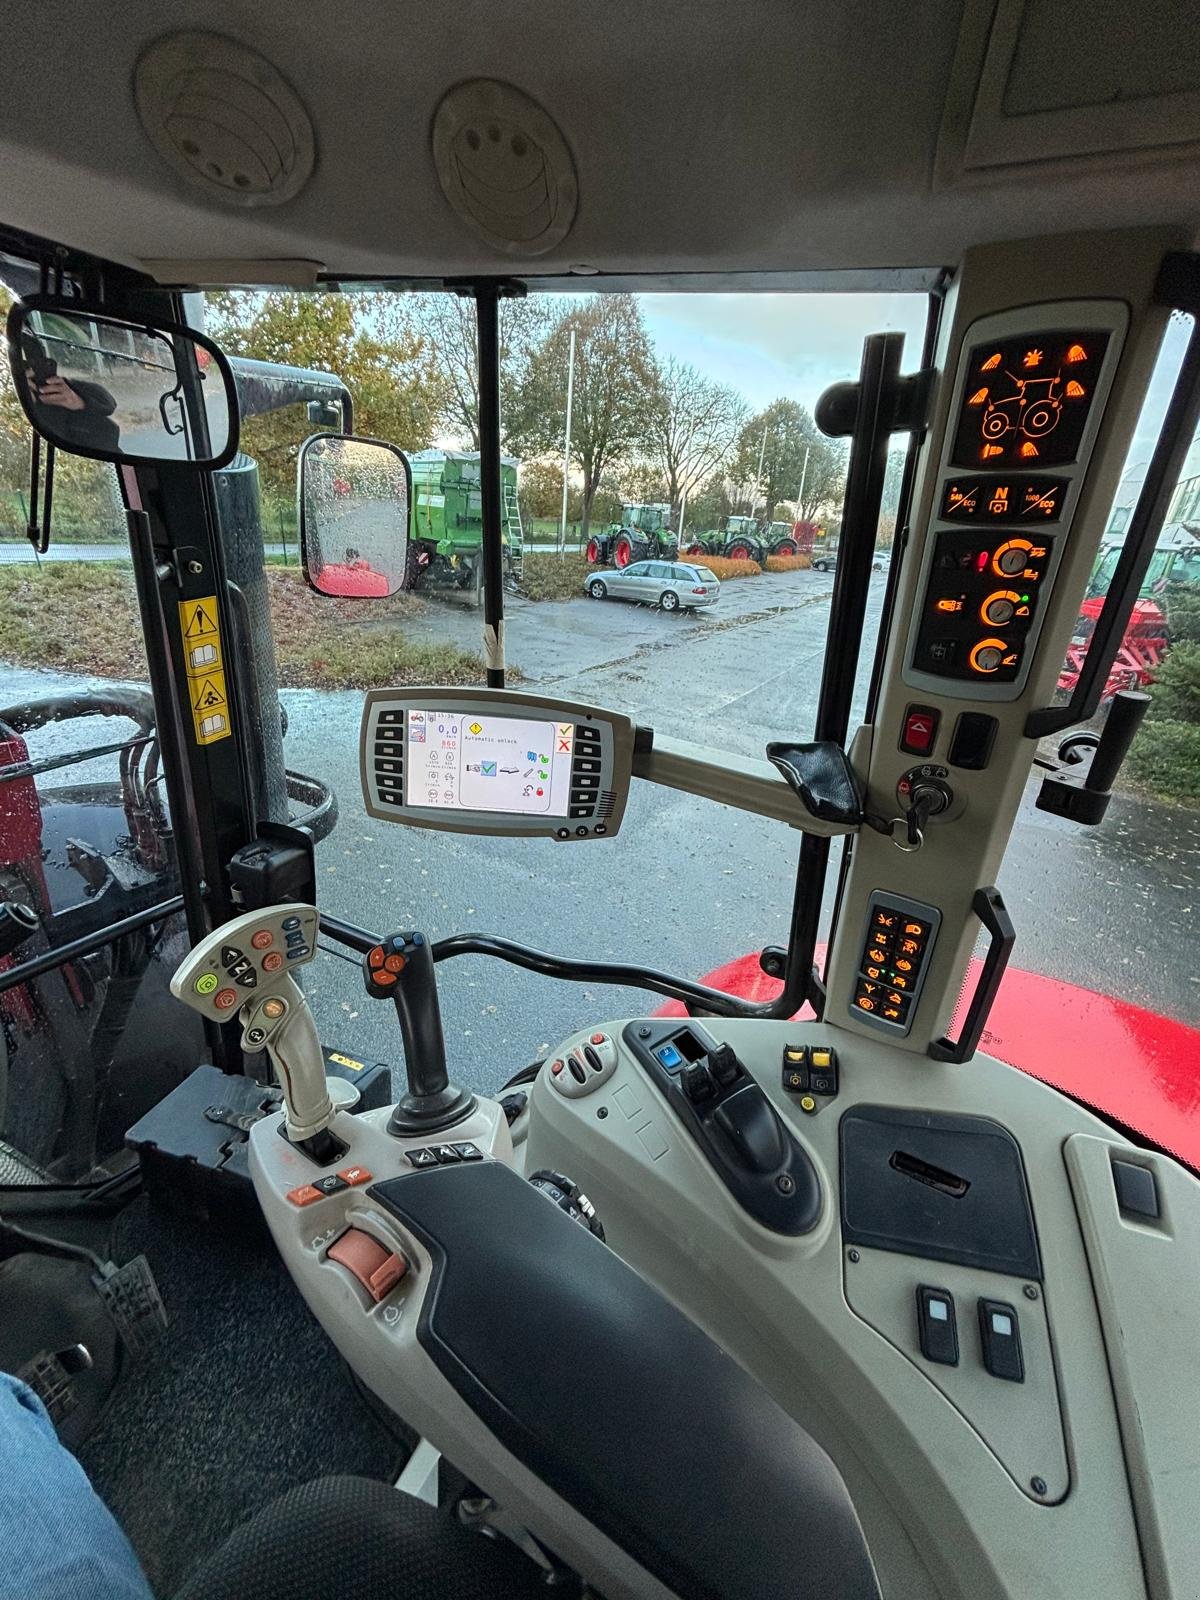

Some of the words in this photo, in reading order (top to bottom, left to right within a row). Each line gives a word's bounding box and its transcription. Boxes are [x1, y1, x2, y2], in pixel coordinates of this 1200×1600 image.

[950, 493, 963, 501] 540
[994, 487, 1009, 499] N
[1039, 500, 1055, 508] ECO
[550, 1189, 561, 1199] 3
